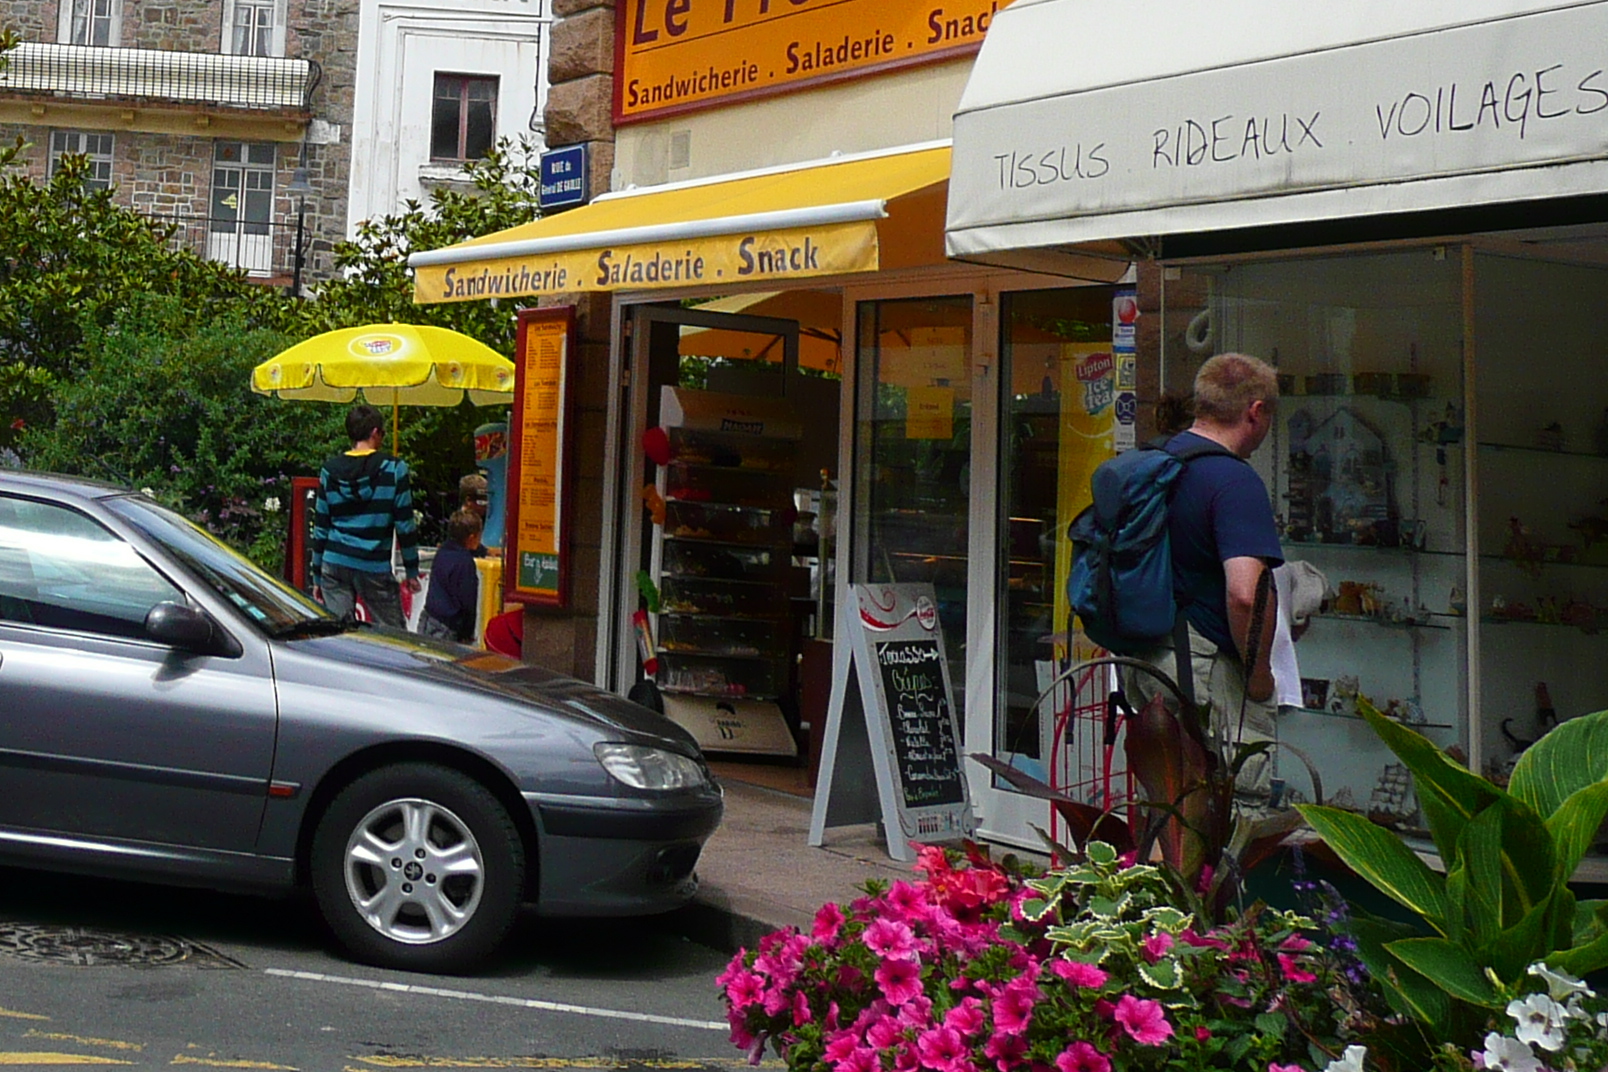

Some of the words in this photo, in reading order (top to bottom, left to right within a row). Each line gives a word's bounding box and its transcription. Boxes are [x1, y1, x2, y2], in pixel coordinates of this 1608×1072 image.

[627, 60, 758, 107] Sandwicherie
[786, 29, 894, 74] Saladerie
[994, 143, 1110, 191] TISSUS
[1151, 112, 1323, 170] RIDEAUX
[1376, 64, 1608, 140] VOILAGES
[443, 263, 567, 298] Sandwicherie
[596, 250, 705, 286] Saladerie
[738, 236, 820, 275] Snack
[1078, 358, 1111, 377] Lipton
[1088, 379, 1108, 393] Ice
